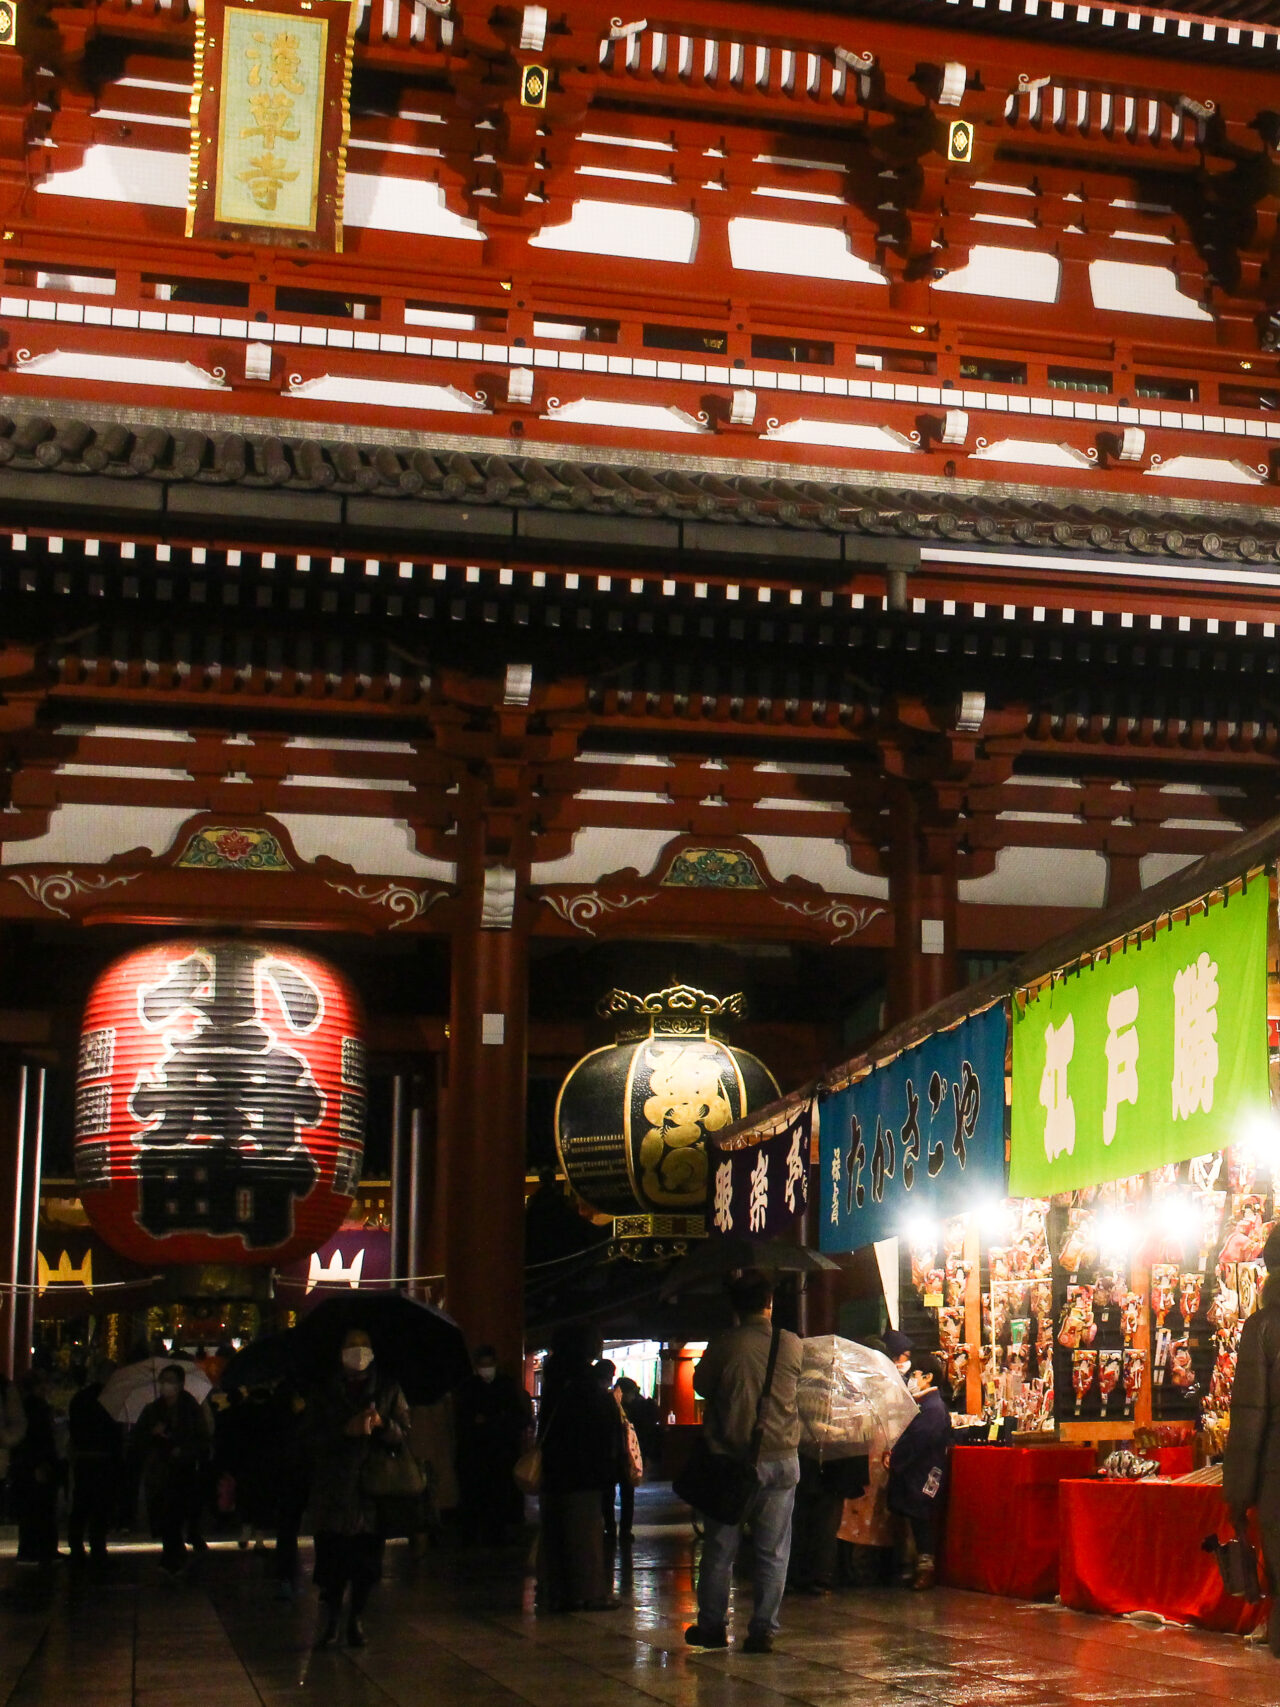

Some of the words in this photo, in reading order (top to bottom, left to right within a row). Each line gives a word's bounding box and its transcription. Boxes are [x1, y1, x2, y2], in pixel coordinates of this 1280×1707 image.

[126, 943, 328, 1253] 小舟町
[846, 1060, 981, 1215] たかさごや
